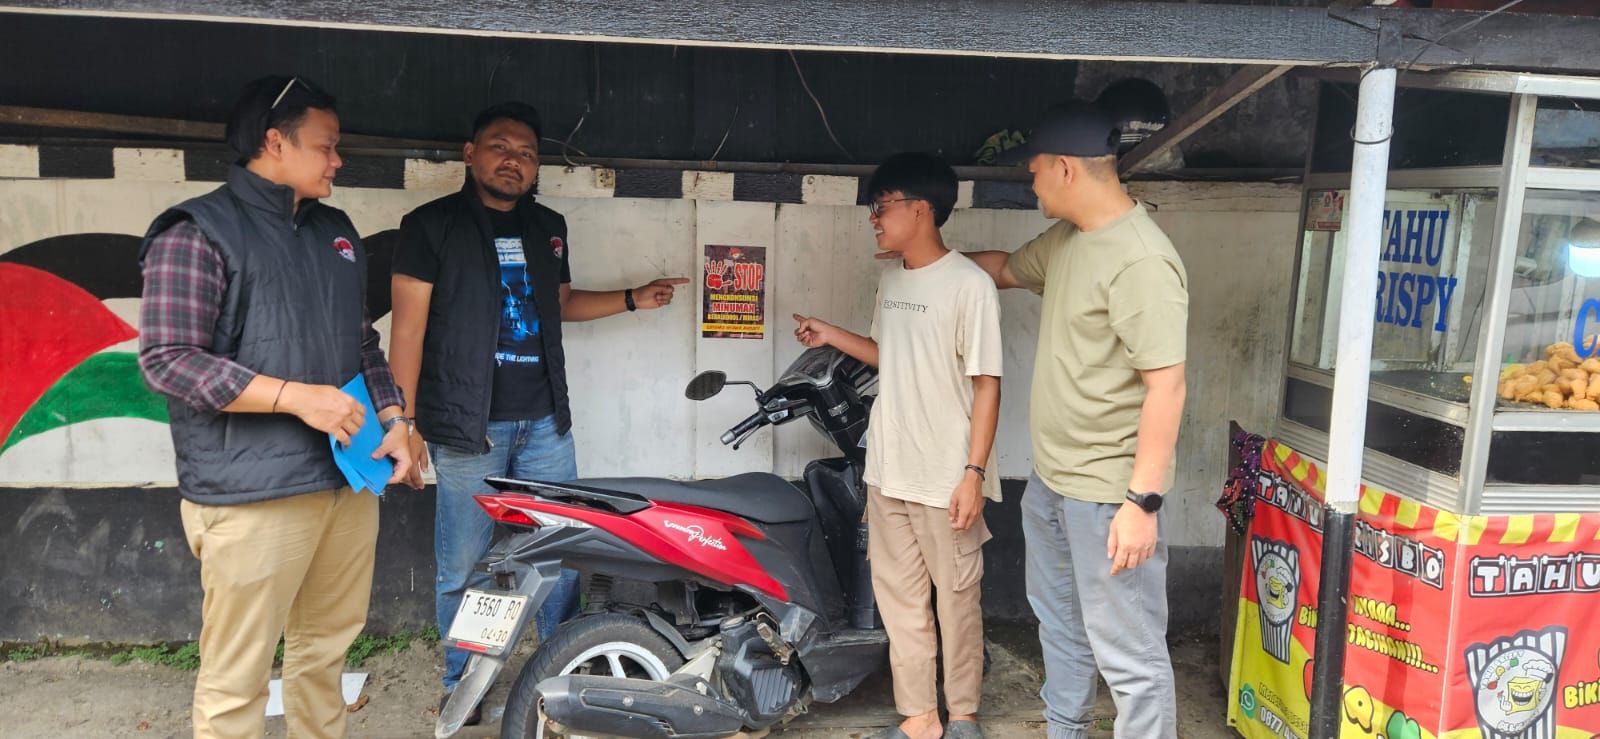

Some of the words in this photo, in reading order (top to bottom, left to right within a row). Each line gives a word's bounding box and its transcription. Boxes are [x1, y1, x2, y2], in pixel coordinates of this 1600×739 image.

[734, 263, 764, 290] STOP
[712, 302, 756, 313] MINUMAN
[883, 299, 928, 313] POSITIVITY
[461, 594, 471, 613] T
[473, 596, 502, 617] 5560
